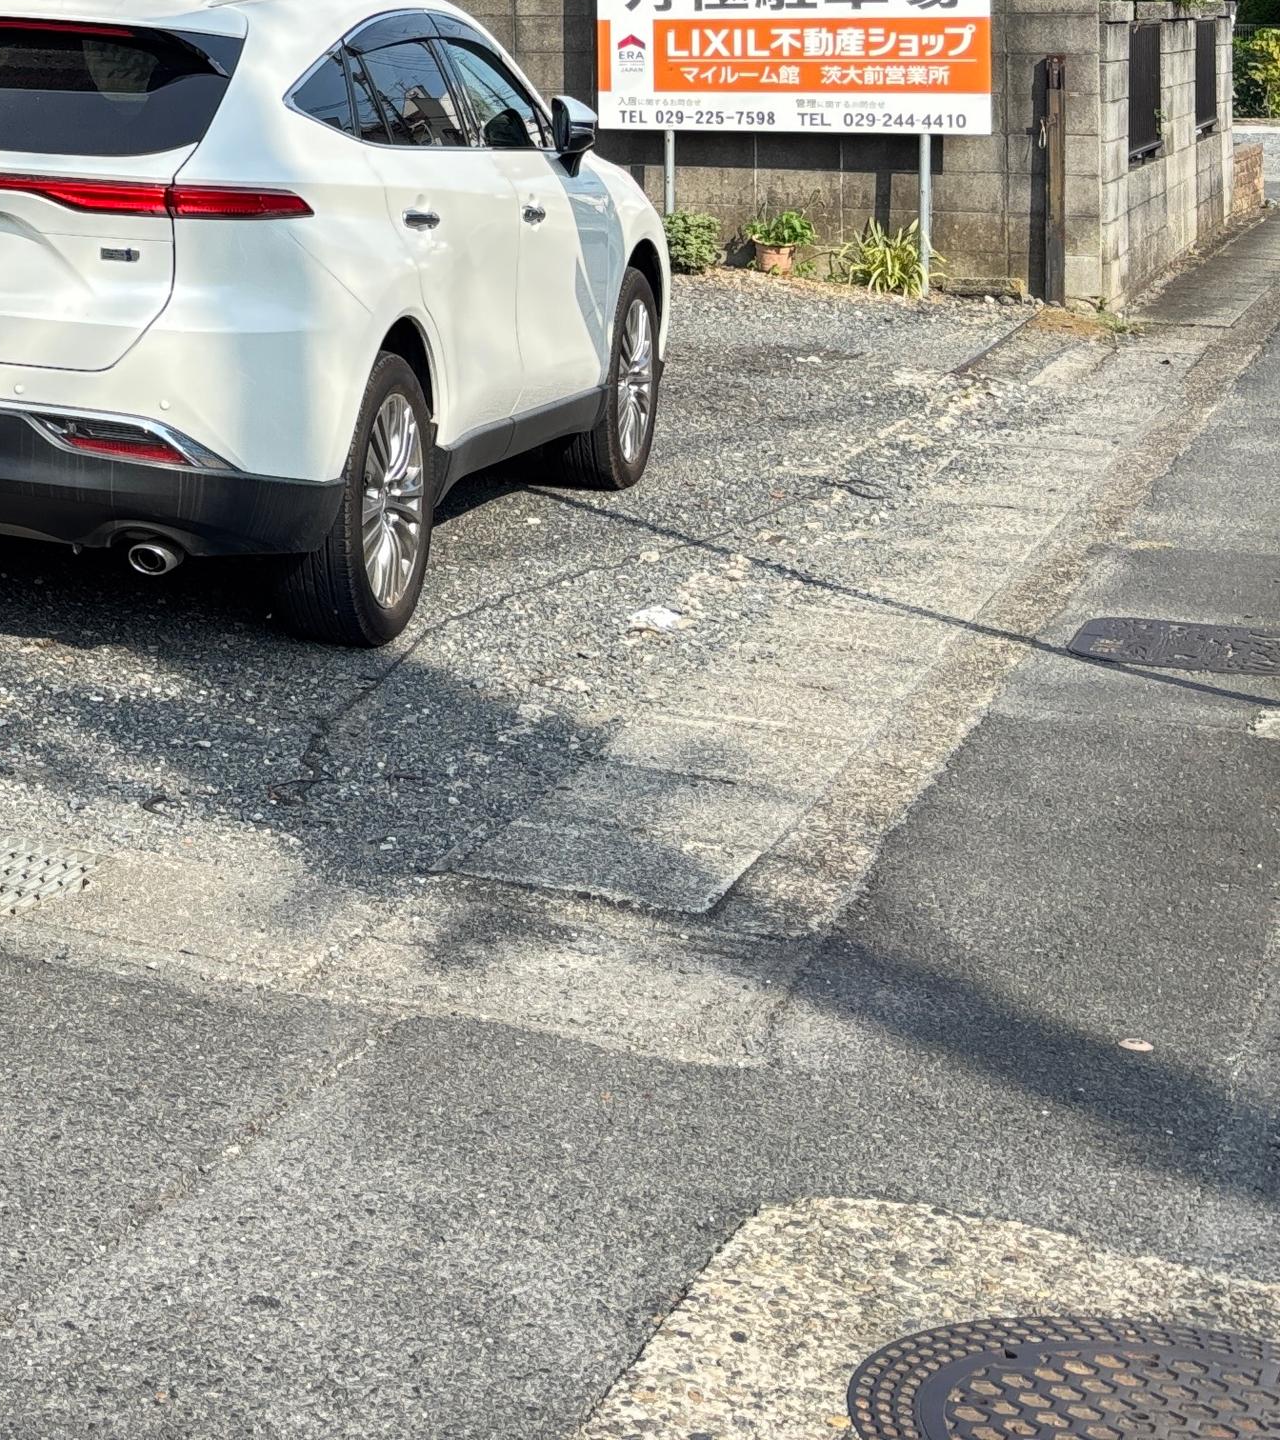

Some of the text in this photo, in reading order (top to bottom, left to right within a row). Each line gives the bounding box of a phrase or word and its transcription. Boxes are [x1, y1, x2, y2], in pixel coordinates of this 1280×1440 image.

[666, 23, 977, 58] LIXIL不動産ショップ
[618, 50, 645, 60] ERA
[682, 65, 949, 85] マイルーム館 茨大前営業所
[619, 110, 775, 125] TEL 029-225-7598
[797, 112, 967, 128] TEL 029-244-4410
